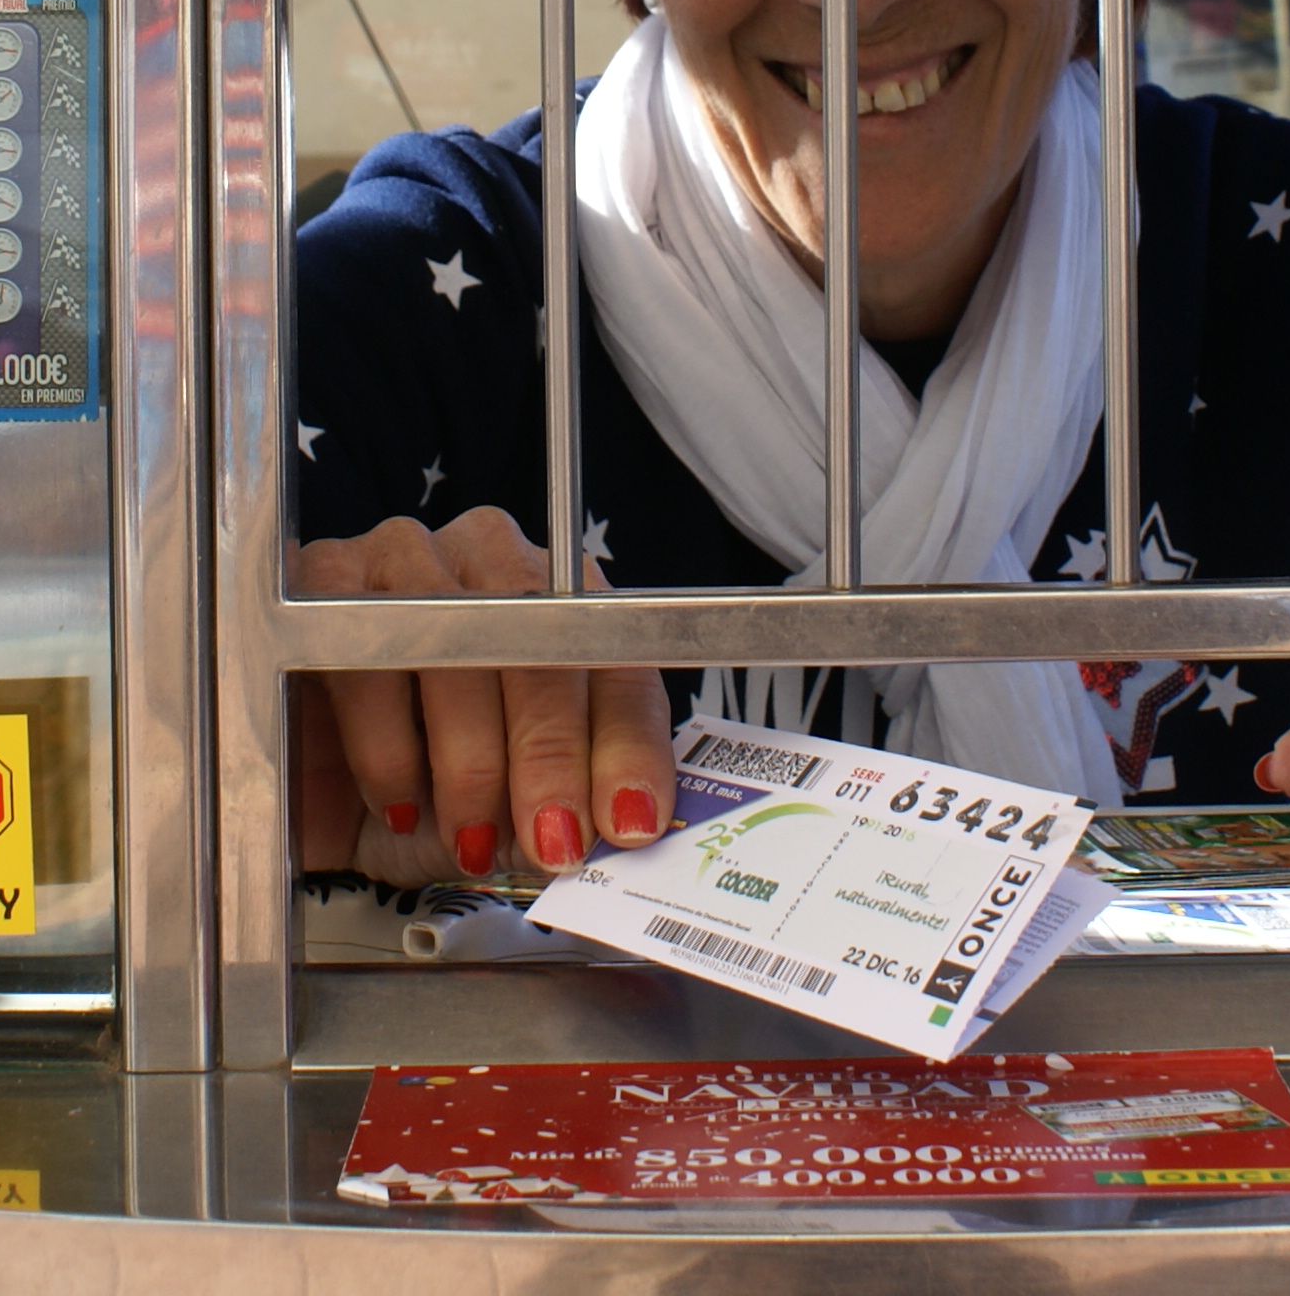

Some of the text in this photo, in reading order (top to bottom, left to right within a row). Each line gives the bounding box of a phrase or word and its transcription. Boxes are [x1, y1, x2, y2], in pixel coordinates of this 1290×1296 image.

[849, 767, 886, 785] SERIE
[836, 780, 1058, 851] 011 63424
[716, 869, 780, 903] COCEDER
[958, 864, 1032, 958] ONCE
[843, 946, 921, 985] 22 DIC. 16
[611, 1080, 1049, 1103] NAVIDAD
[635, 1145, 963, 1167] 850.000
[739, 1167, 1021, 1186] 400.000
